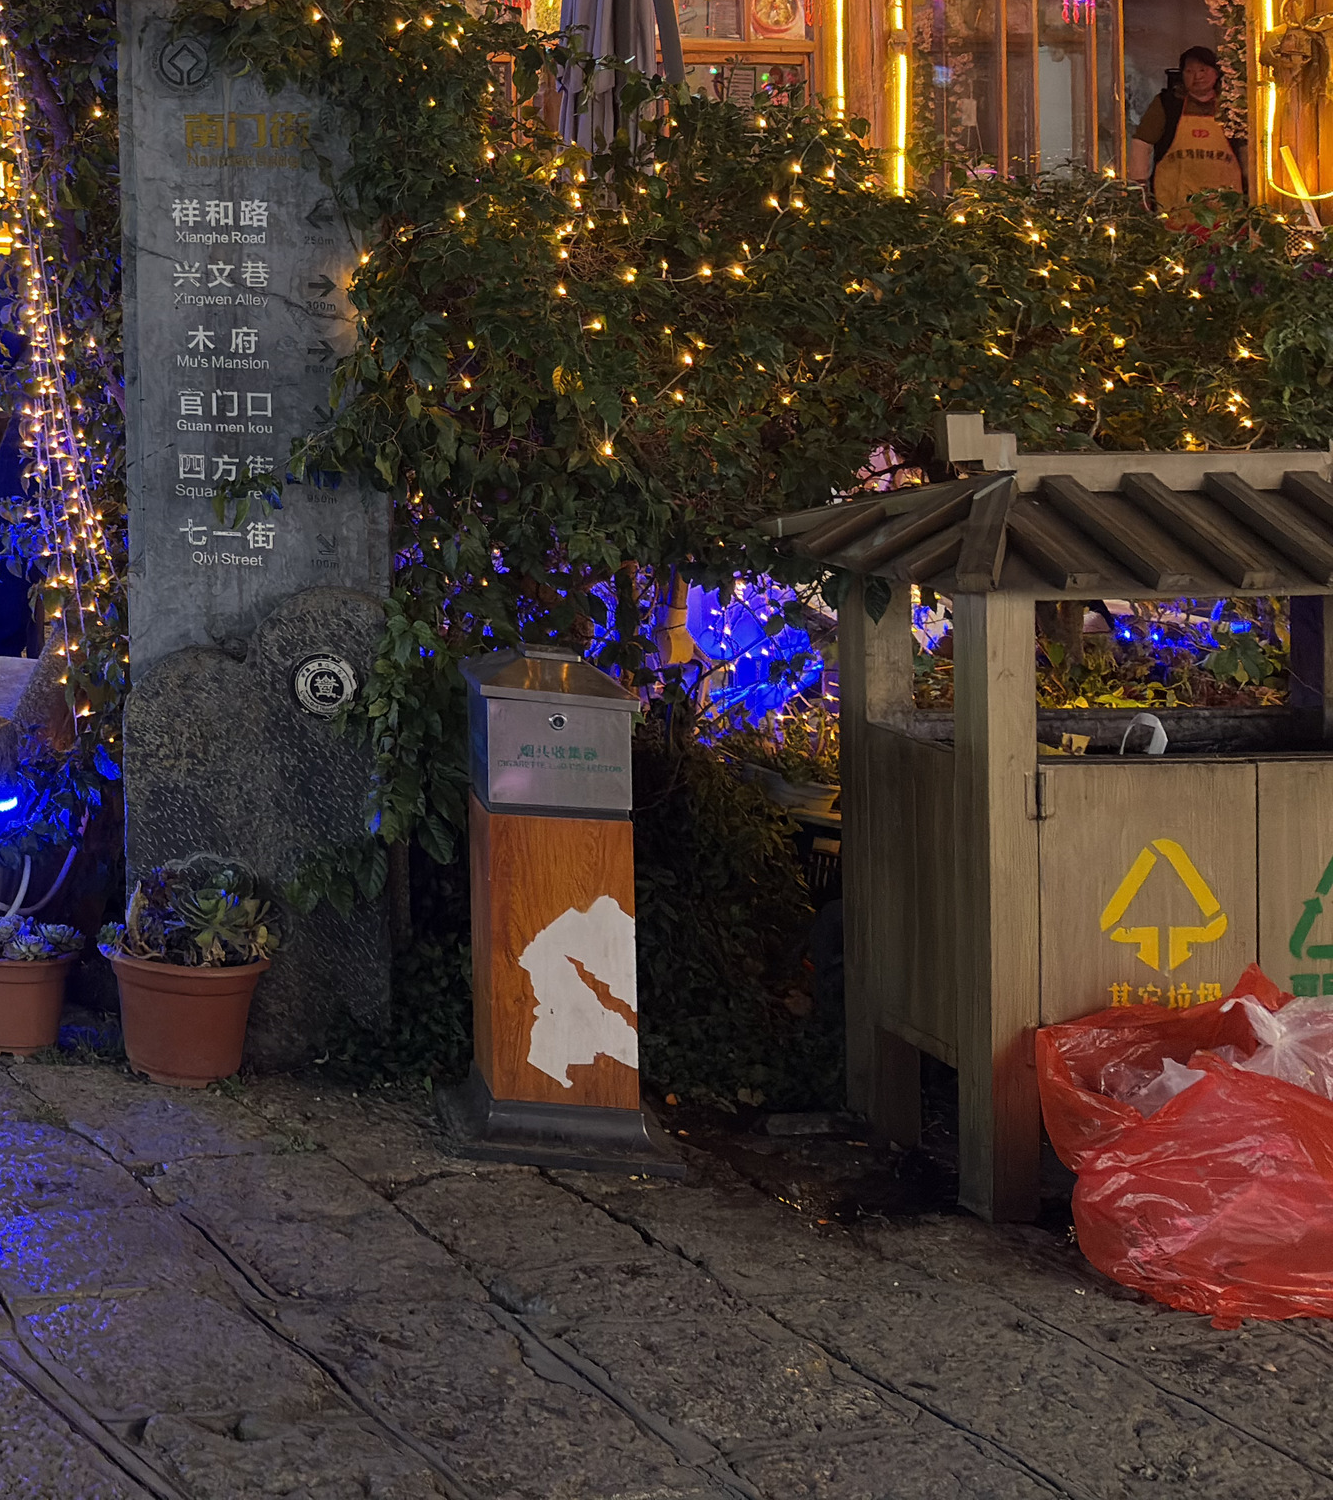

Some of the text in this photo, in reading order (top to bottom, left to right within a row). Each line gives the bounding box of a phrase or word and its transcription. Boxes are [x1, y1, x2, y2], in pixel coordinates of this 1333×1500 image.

[184, 111, 311, 149] 南门街
[172, 199, 269, 228] 祥和路
[175, 231, 335, 246] Xianghe Road 250m
[173, 260, 270, 288] 兴文巷
[174, 293, 336, 312] Xingwen Alley 300m
[188, 325, 259, 354] 木府
[177, 355, 209, 369] Mu's
[212, 356, 270, 370] Mansion
[178, 388, 272, 418] 官门口
[177, 419, 273, 434] Guan men kou
[178, 454, 274, 482] 四方街
[179, 518, 276, 550] 七一街
[192, 551, 340, 569] Qiyi Street 100m
[1107, 981, 1223, 1009] 其它垃圾
